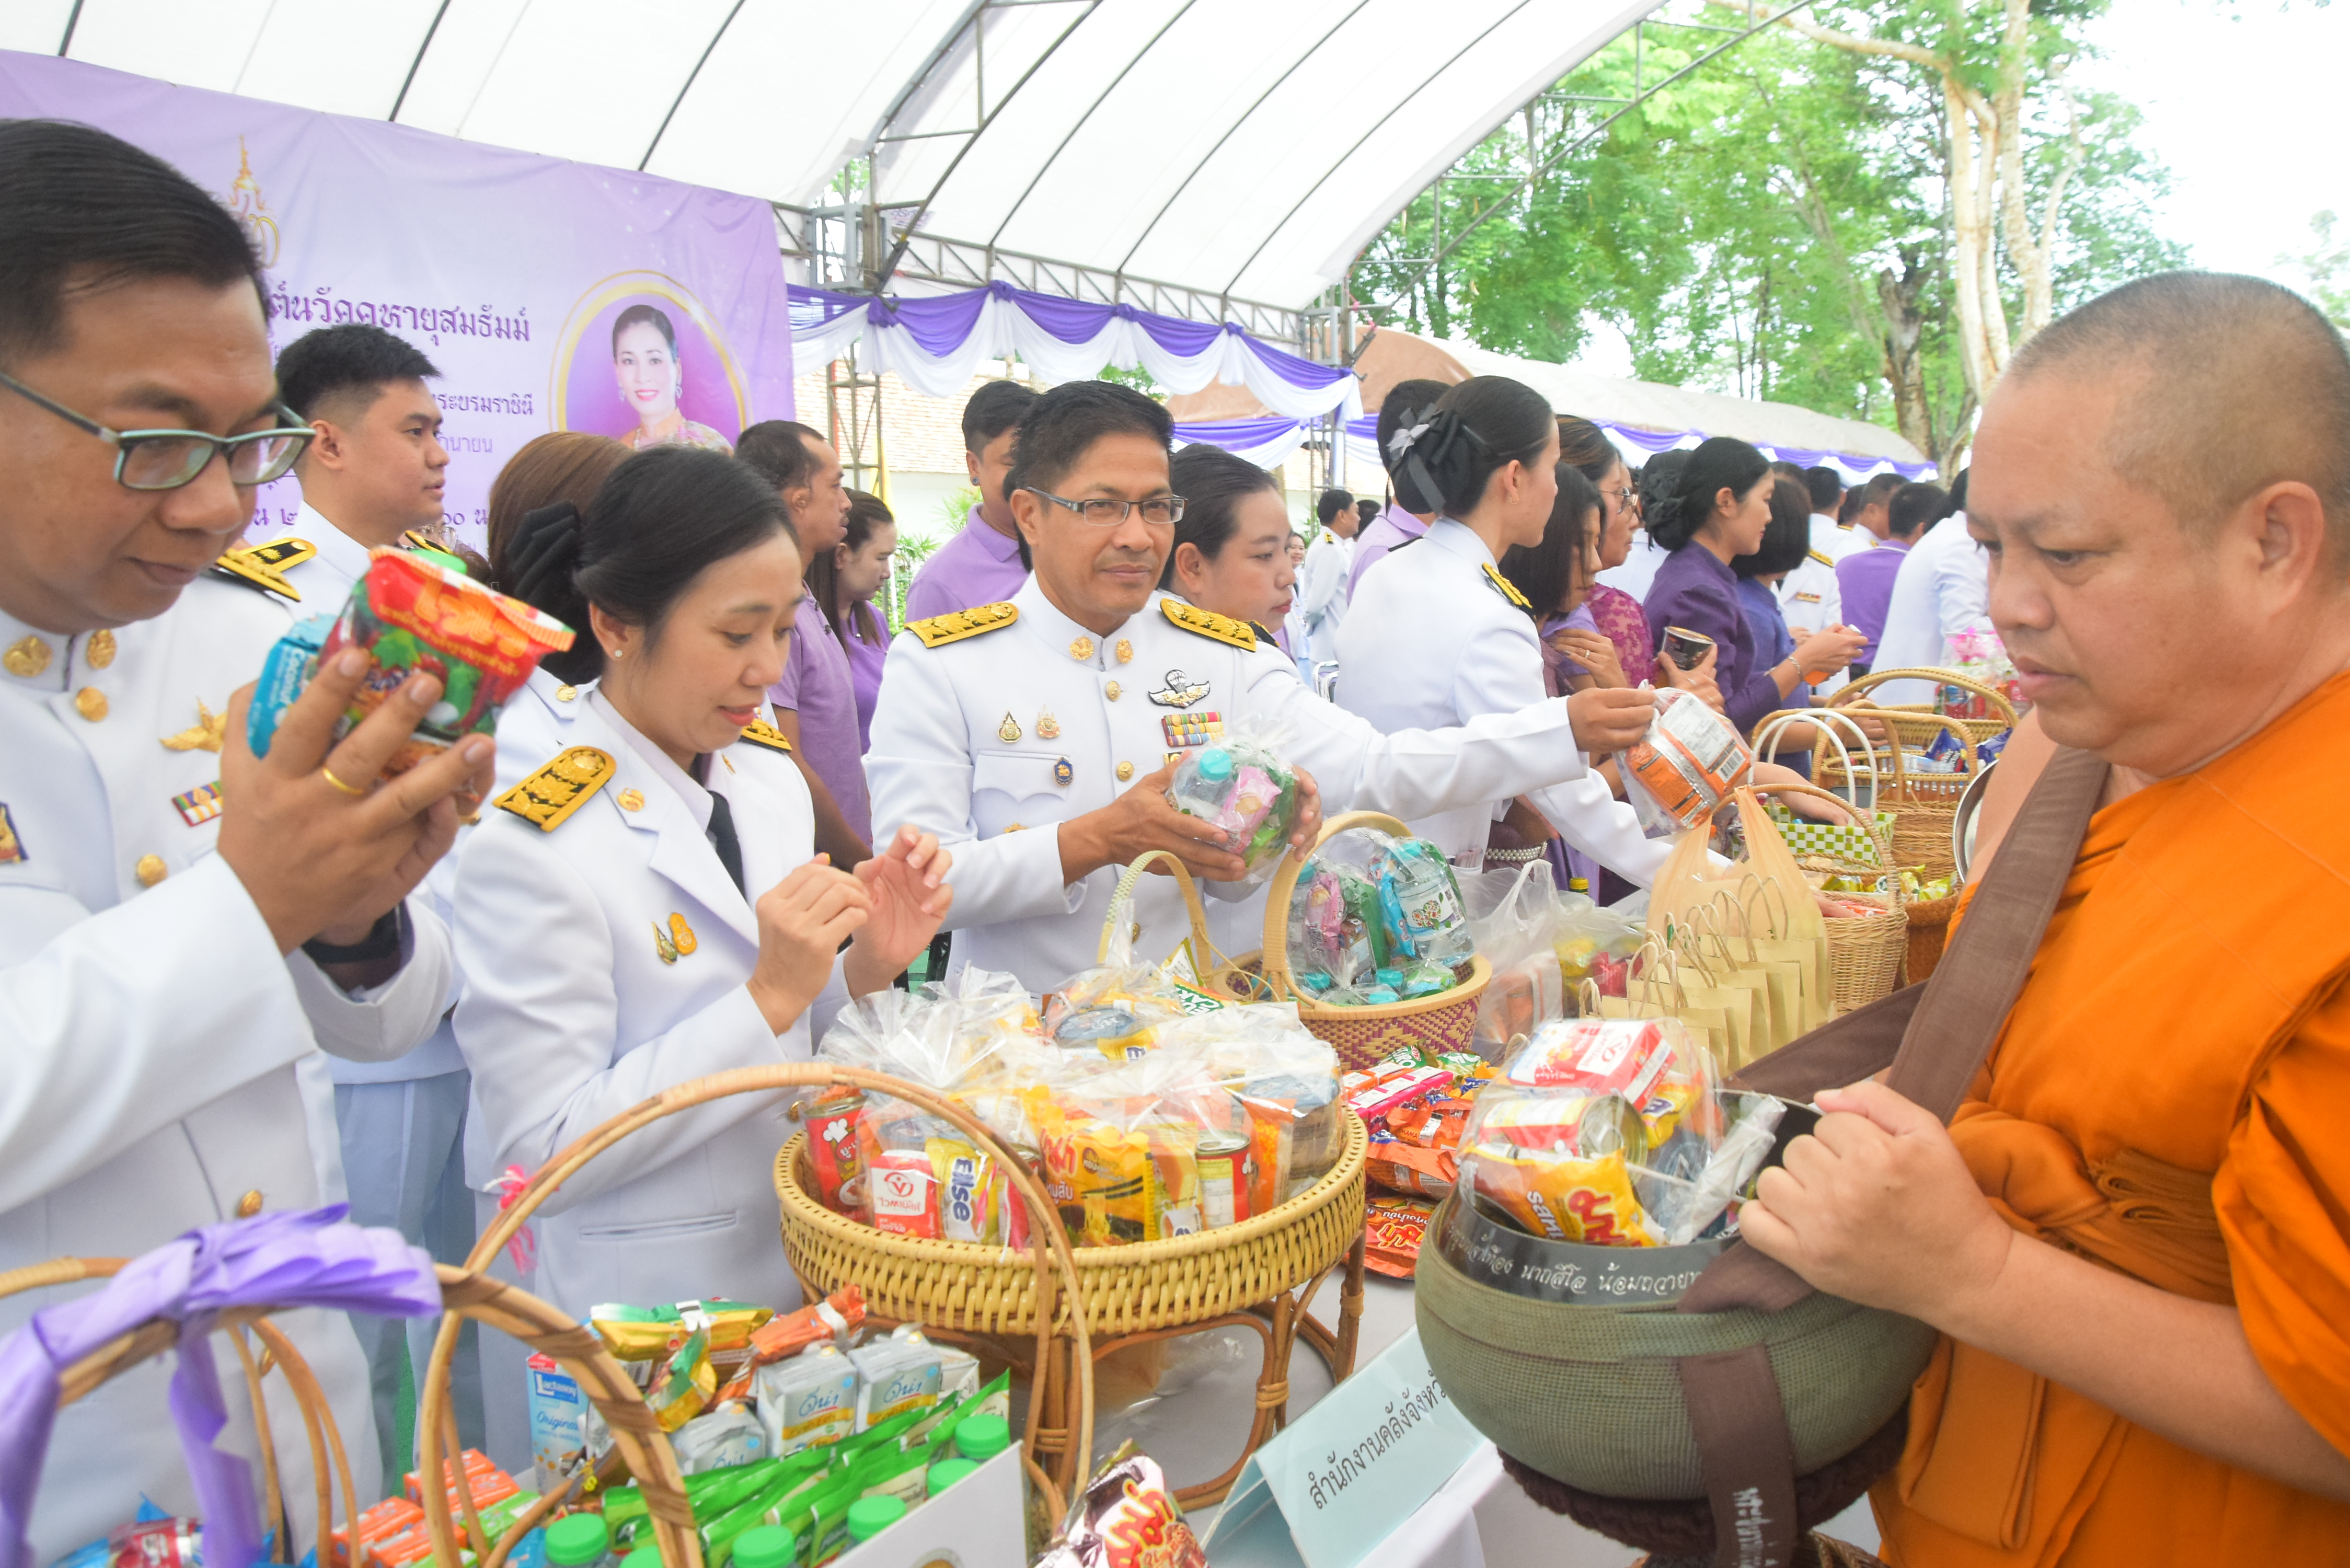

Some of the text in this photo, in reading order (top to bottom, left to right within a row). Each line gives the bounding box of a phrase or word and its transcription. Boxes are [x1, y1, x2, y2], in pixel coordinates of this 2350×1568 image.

[1182, 1002, 1210, 1015] EU
[537, 1411, 579, 1431] Origina
[1309, 1369, 1446, 1509] สำนักงานคลังจังหวั
